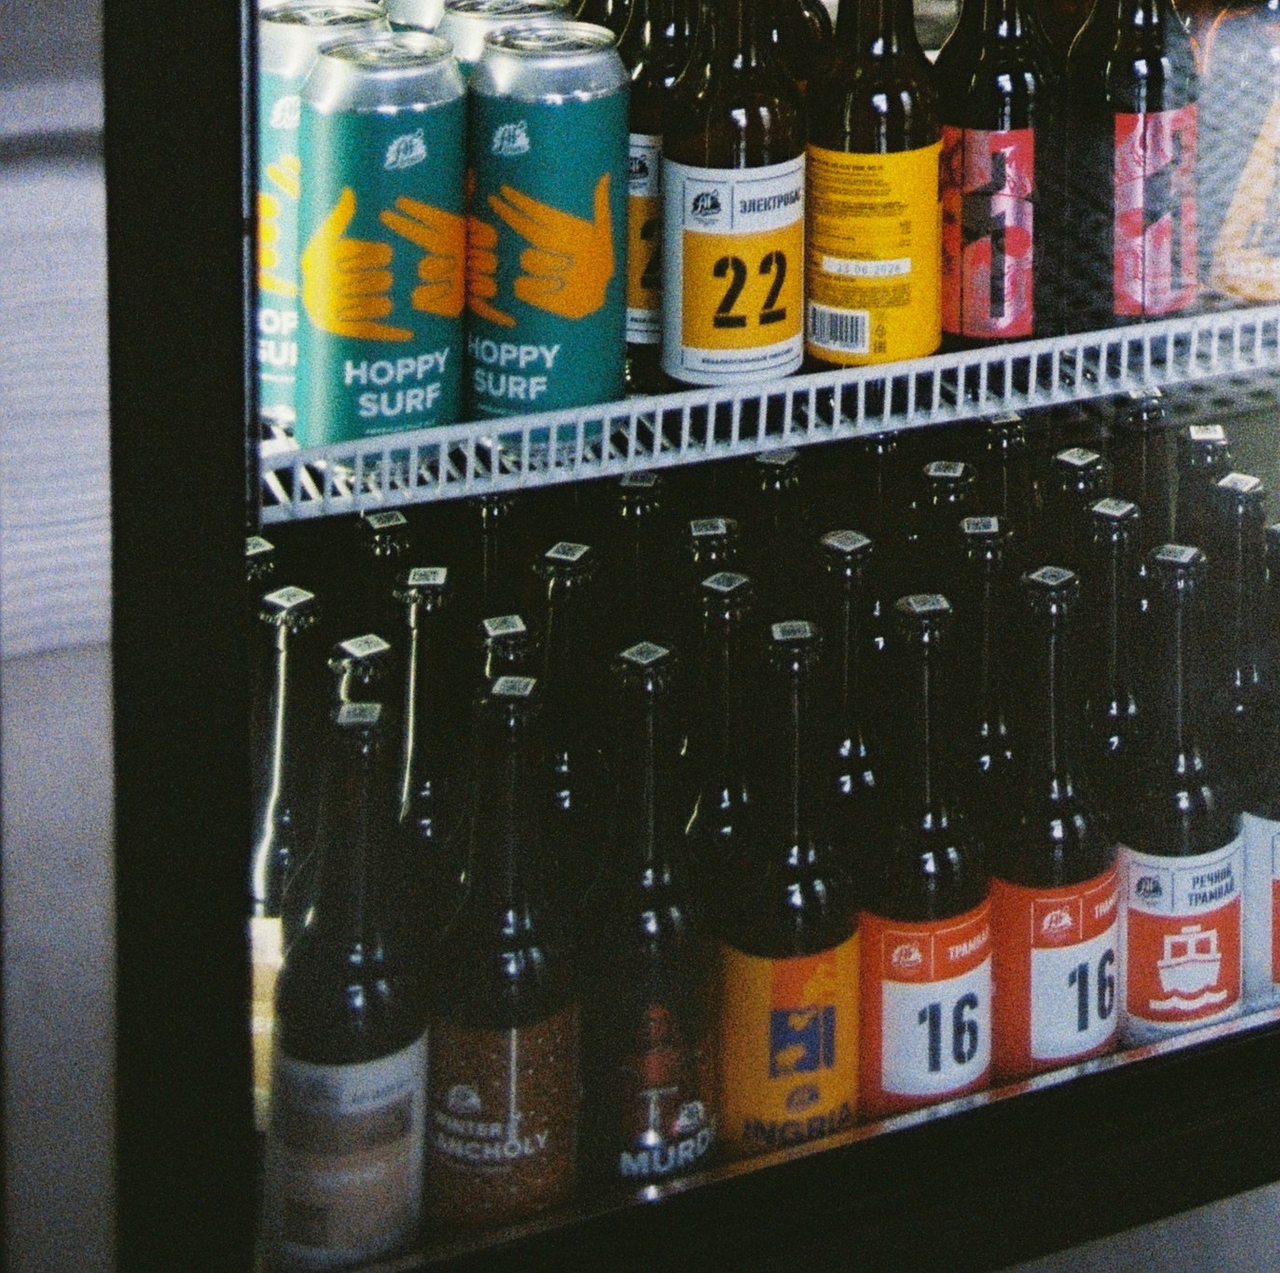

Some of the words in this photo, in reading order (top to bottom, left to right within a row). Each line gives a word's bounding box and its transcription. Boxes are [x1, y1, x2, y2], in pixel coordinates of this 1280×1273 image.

[711, 250, 788, 330] 22
[343, 347, 449, 385] HOPPY
[468, 334, 560, 369] HOPPY
[358, 383, 441, 418] SURF
[473, 367, 547, 400] SURF
[1068, 948, 1114, 1033] 16
[917, 992, 979, 1073] 16
[743, 1101, 850, 1144] INGRIA
